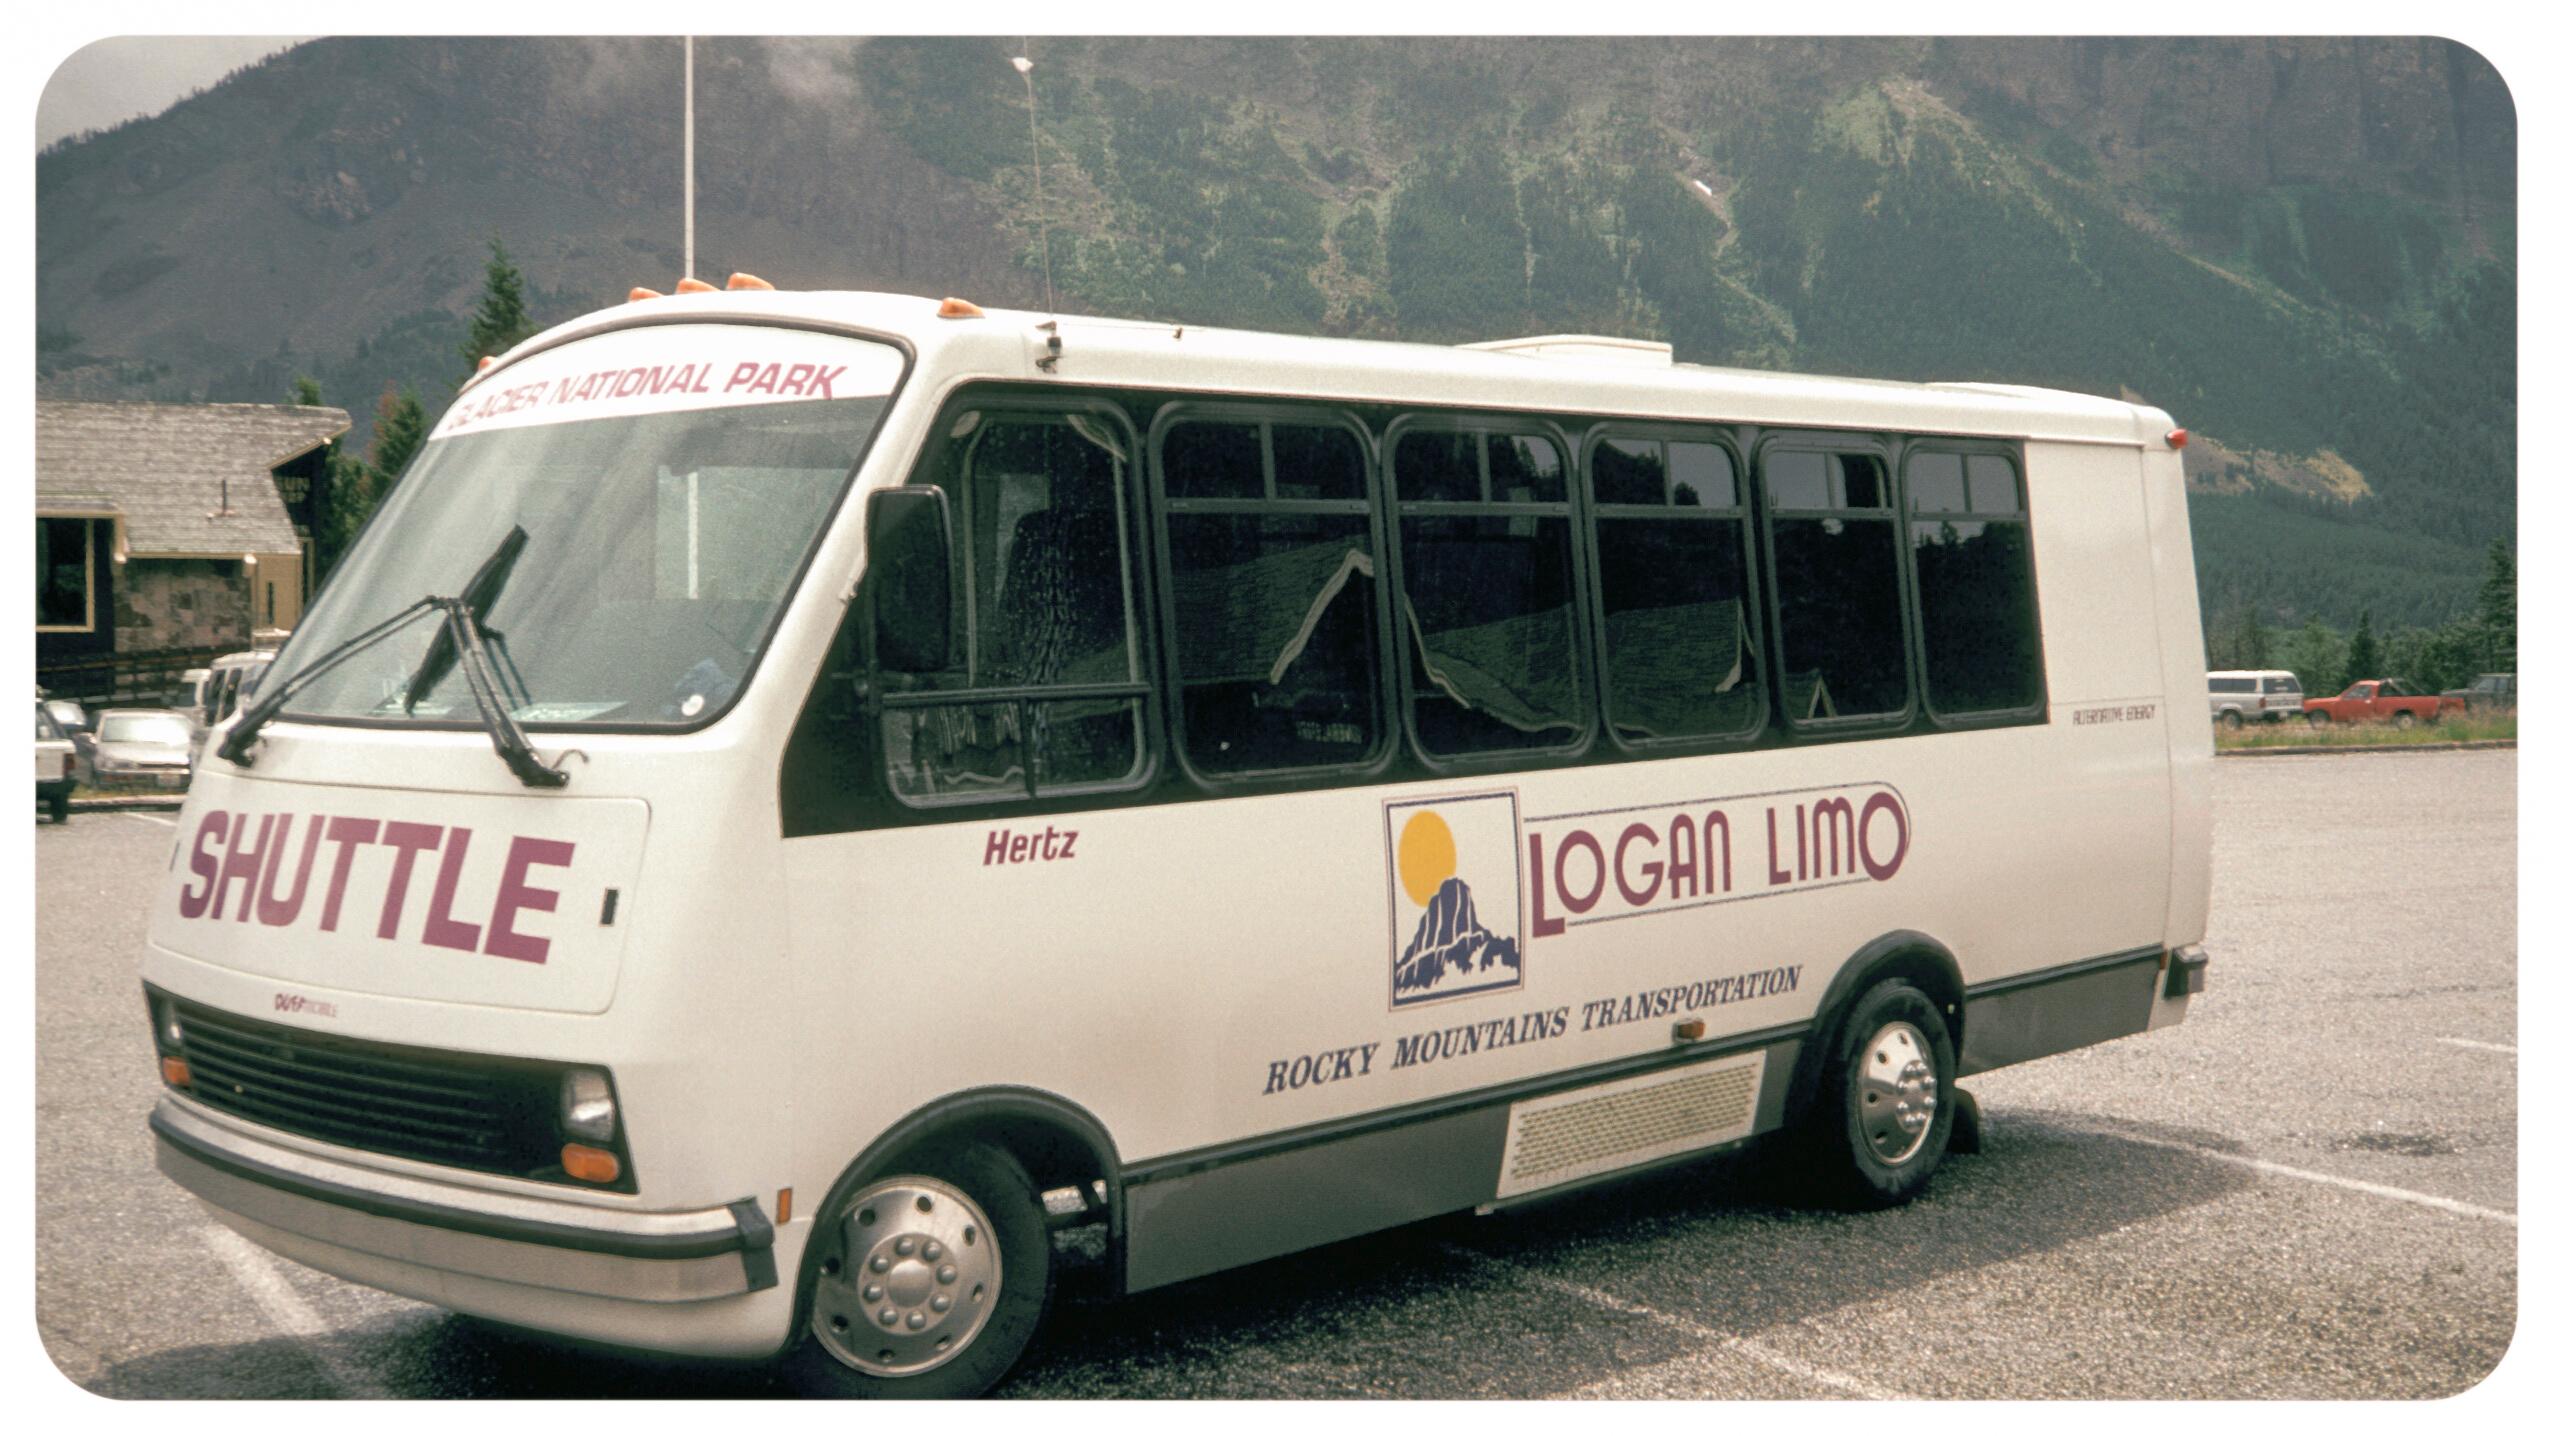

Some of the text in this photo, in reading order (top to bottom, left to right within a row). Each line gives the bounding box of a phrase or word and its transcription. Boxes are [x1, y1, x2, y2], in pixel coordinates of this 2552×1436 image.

[448, 361, 848, 430] GLACIER NATIONAL PARK
[179, 809, 577, 965] SHUTTLE
[983, 824, 1080, 866] Hertz
[1529, 791, 1907, 939] LOGAN LIMO
[1262, 965, 1803, 1096] ROCKY MOUNTAINS TRANSPORTATION
